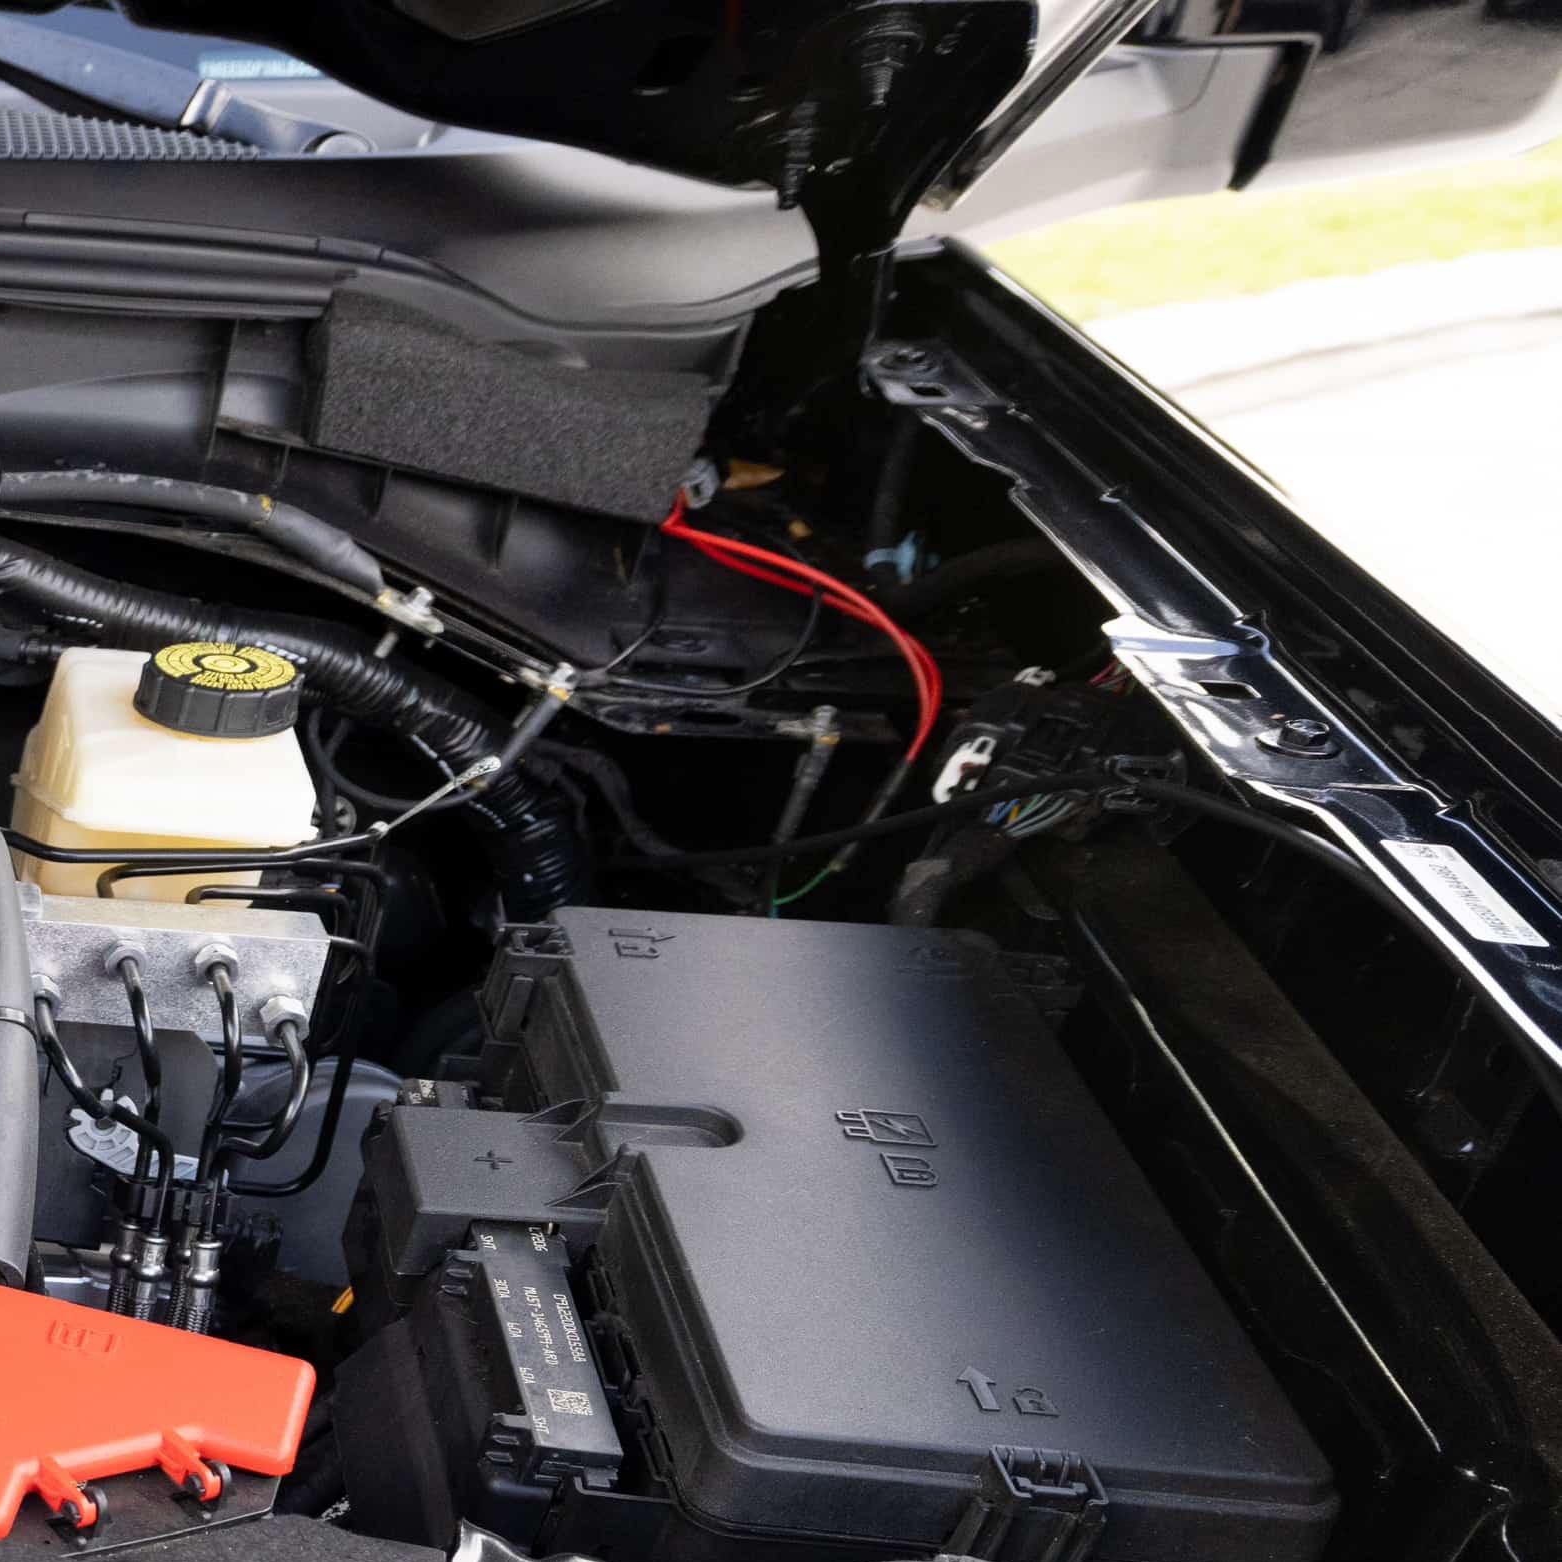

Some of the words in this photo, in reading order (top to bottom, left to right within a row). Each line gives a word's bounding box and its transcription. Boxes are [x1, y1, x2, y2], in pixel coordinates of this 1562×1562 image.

[480, 1234, 497, 1250] SHT
[493, 1278, 510, 1298] 300A
[507, 1321, 523, 1337] 60A
[519, 1367, 536, 1384] 60A
[532, 1415, 549, 1434] SHT
